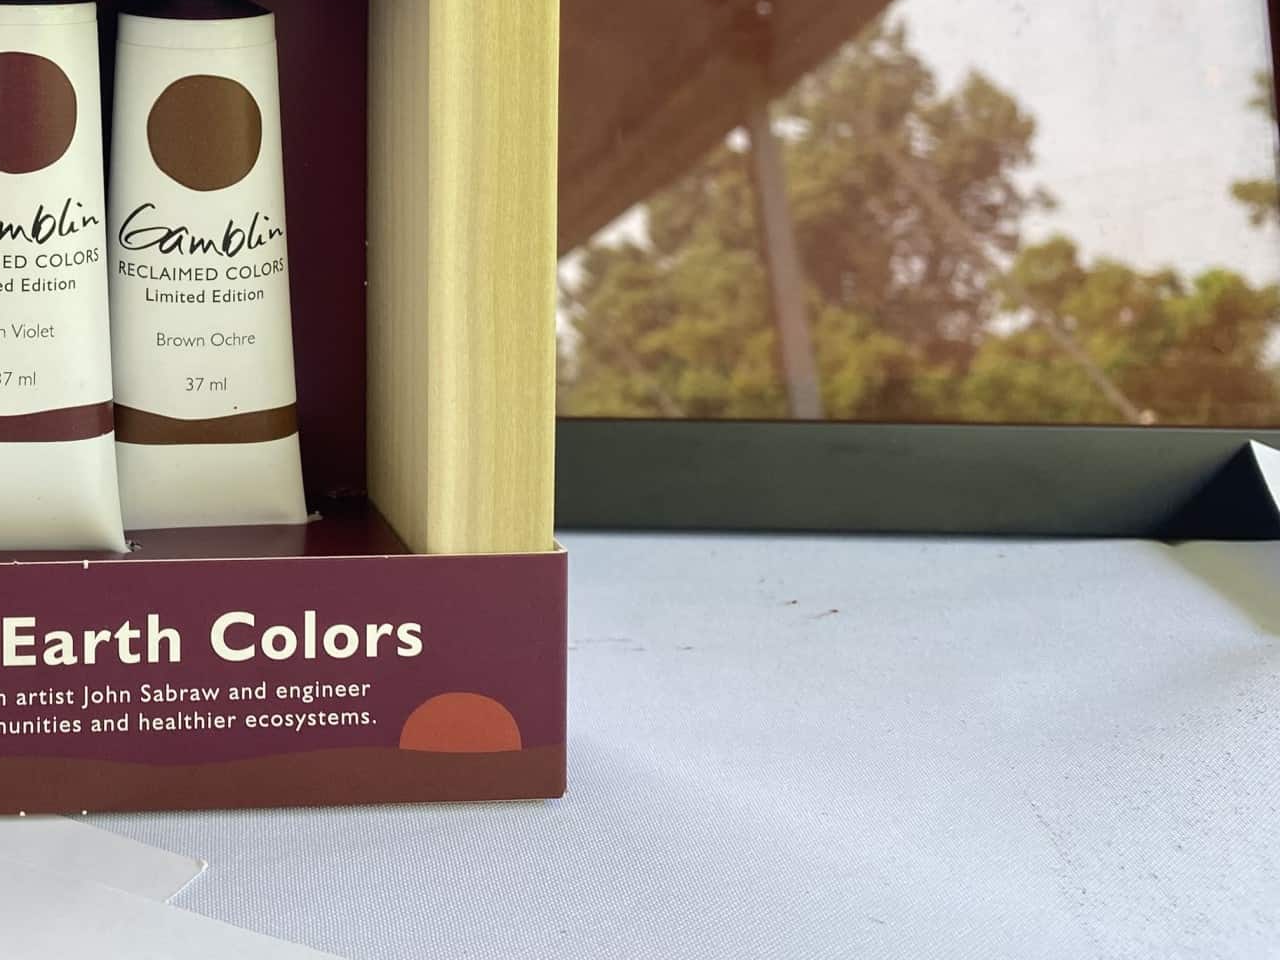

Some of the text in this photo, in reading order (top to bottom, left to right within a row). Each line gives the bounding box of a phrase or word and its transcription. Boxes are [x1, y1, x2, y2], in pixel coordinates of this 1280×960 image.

[119, 203, 283, 258] Gamblin
[35, 247, 99, 269] COLORS
[119, 258, 284, 281] RECLAIMED COLORS
[21, 277, 76, 292] Edition
[145, 288, 264, 304] Limited Edition
[11, 323, 55, 339] Violet
[156, 332, 256, 347] Brown Ochre
[18, 371, 36, 386] ml
[185, 377, 227, 391] 37 ml
[2, 613, 182, 667] Earth
[210, 610, 424, 662] Colors
[16, 687, 74, 707] artist
[83, 685, 131, 710] John
[140, 683, 220, 704] Sabraw
[228, 682, 267, 702] and
[275, 681, 371, 704] engineer
[90, 713, 130, 734] and
[139, 710, 237, 732] healthier
[245, 708, 377, 733] ecosystems.
